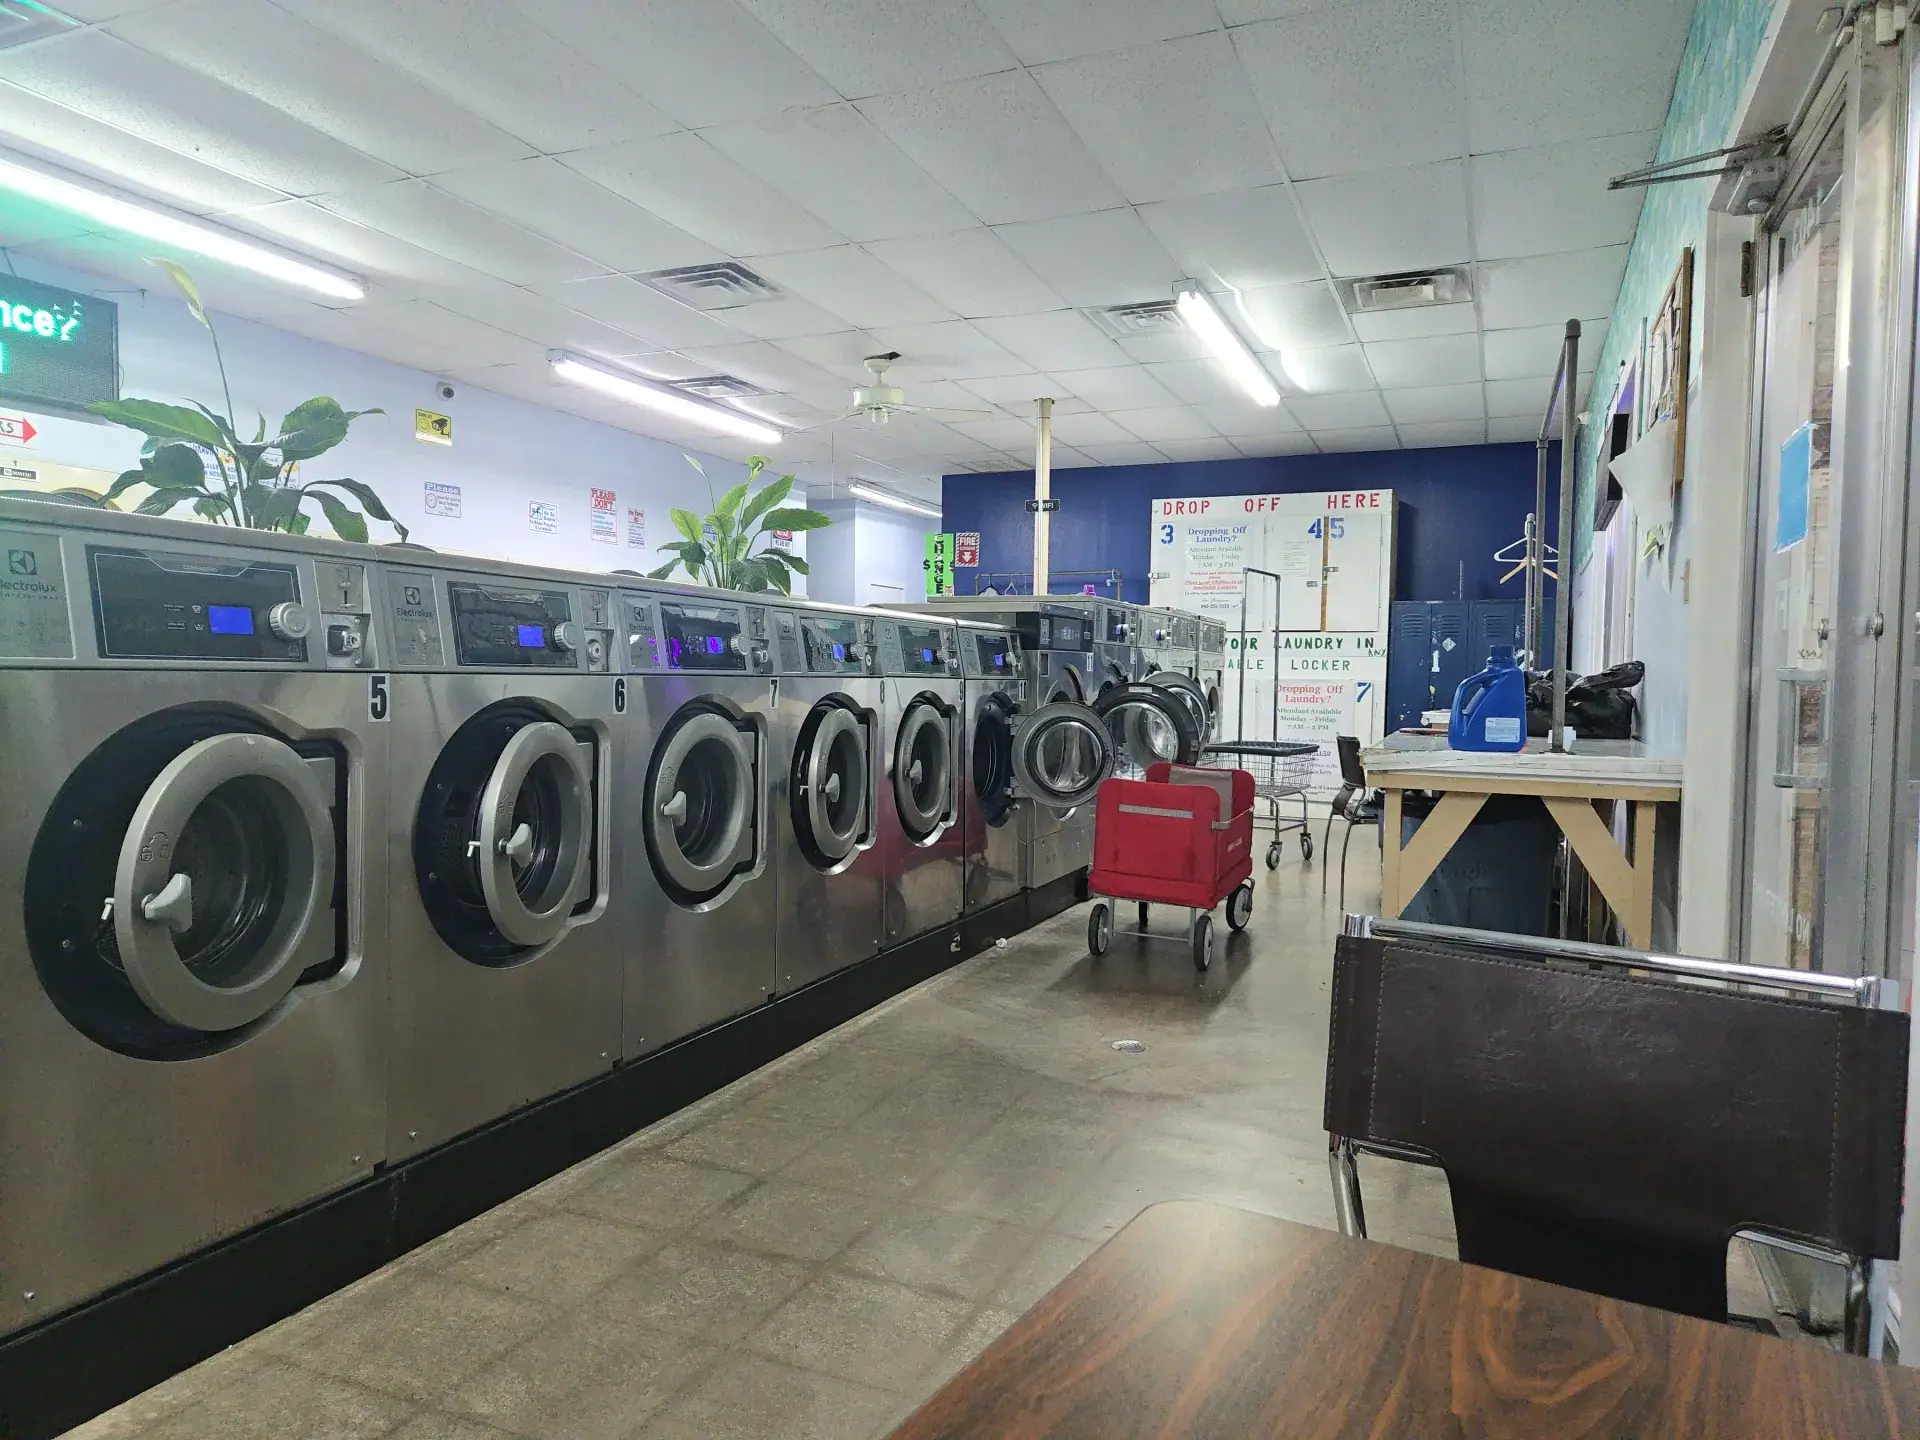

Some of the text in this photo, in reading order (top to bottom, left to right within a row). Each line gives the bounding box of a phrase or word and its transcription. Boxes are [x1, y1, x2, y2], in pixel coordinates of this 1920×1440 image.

[426, 483, 460, 495] Please
[1163, 492, 1380, 516] DROP OFF HERE
[1160, 524, 1174, 545] 3
[1188, 526, 1248, 536] Dropping Off
[1308, 518, 1322, 539] 4
[1330, 517, 1345, 539] 5
[960, 537, 977, 545] FIRE
[1196, 535, 1237, 543] Laundry?
[934, 533, 944, 594] CHANGE
[0, 580, 57, 592] lectrolux
[396, 608, 433, 618] Electrolux
[1357, 637, 1375, 649] IN
[1369, 648, 1386, 657] ANY
[1291, 659, 1350, 671] LOCKER
[1432, 650, 1440, 672] 1
[614, 678, 625, 713] 6
[770, 679, 778, 708] 7
[880, 680, 885, 704] 8
[960, 681, 963, 701] 9
[1277, 685, 1344, 694] Dropping Off
[1357, 682, 1371, 702] 7
[371, 676, 387, 720] 5
[1285, 695, 1332, 704] Laundry?
[1315, 716, 1336, 724] Friday
